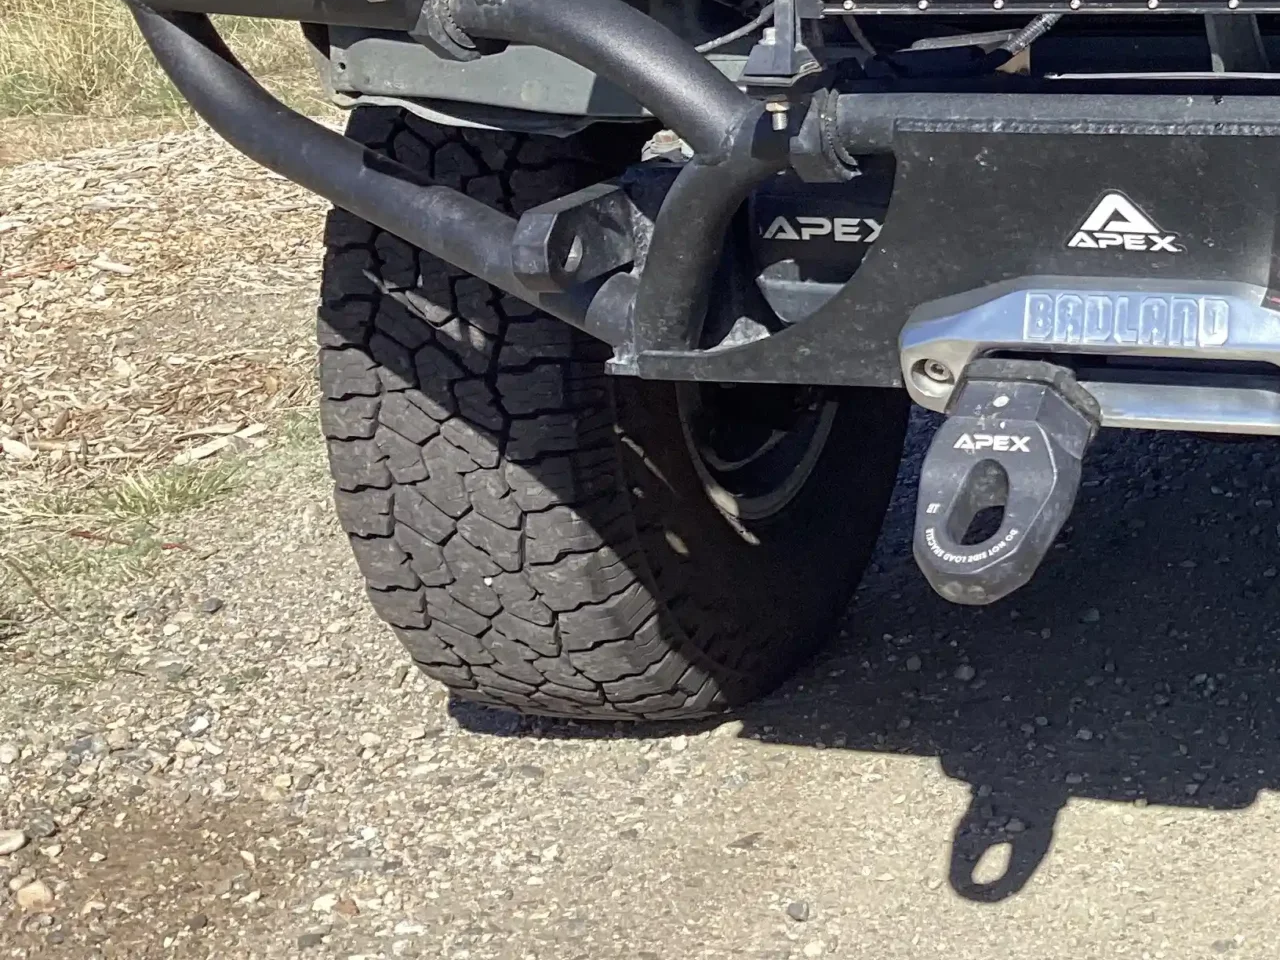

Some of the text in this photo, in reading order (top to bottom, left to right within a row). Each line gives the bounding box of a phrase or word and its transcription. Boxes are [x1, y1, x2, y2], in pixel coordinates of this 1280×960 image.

[1067, 231, 1183, 252] APEX
[1023, 292, 1230, 347] BADLAND
[953, 432, 1032, 453] APEX
[1005, 527, 1019, 542] DO
[967, 551, 987, 563] SIDE
[987, 540, 1006, 557] NOT
[943, 552, 967, 564] LOAD
